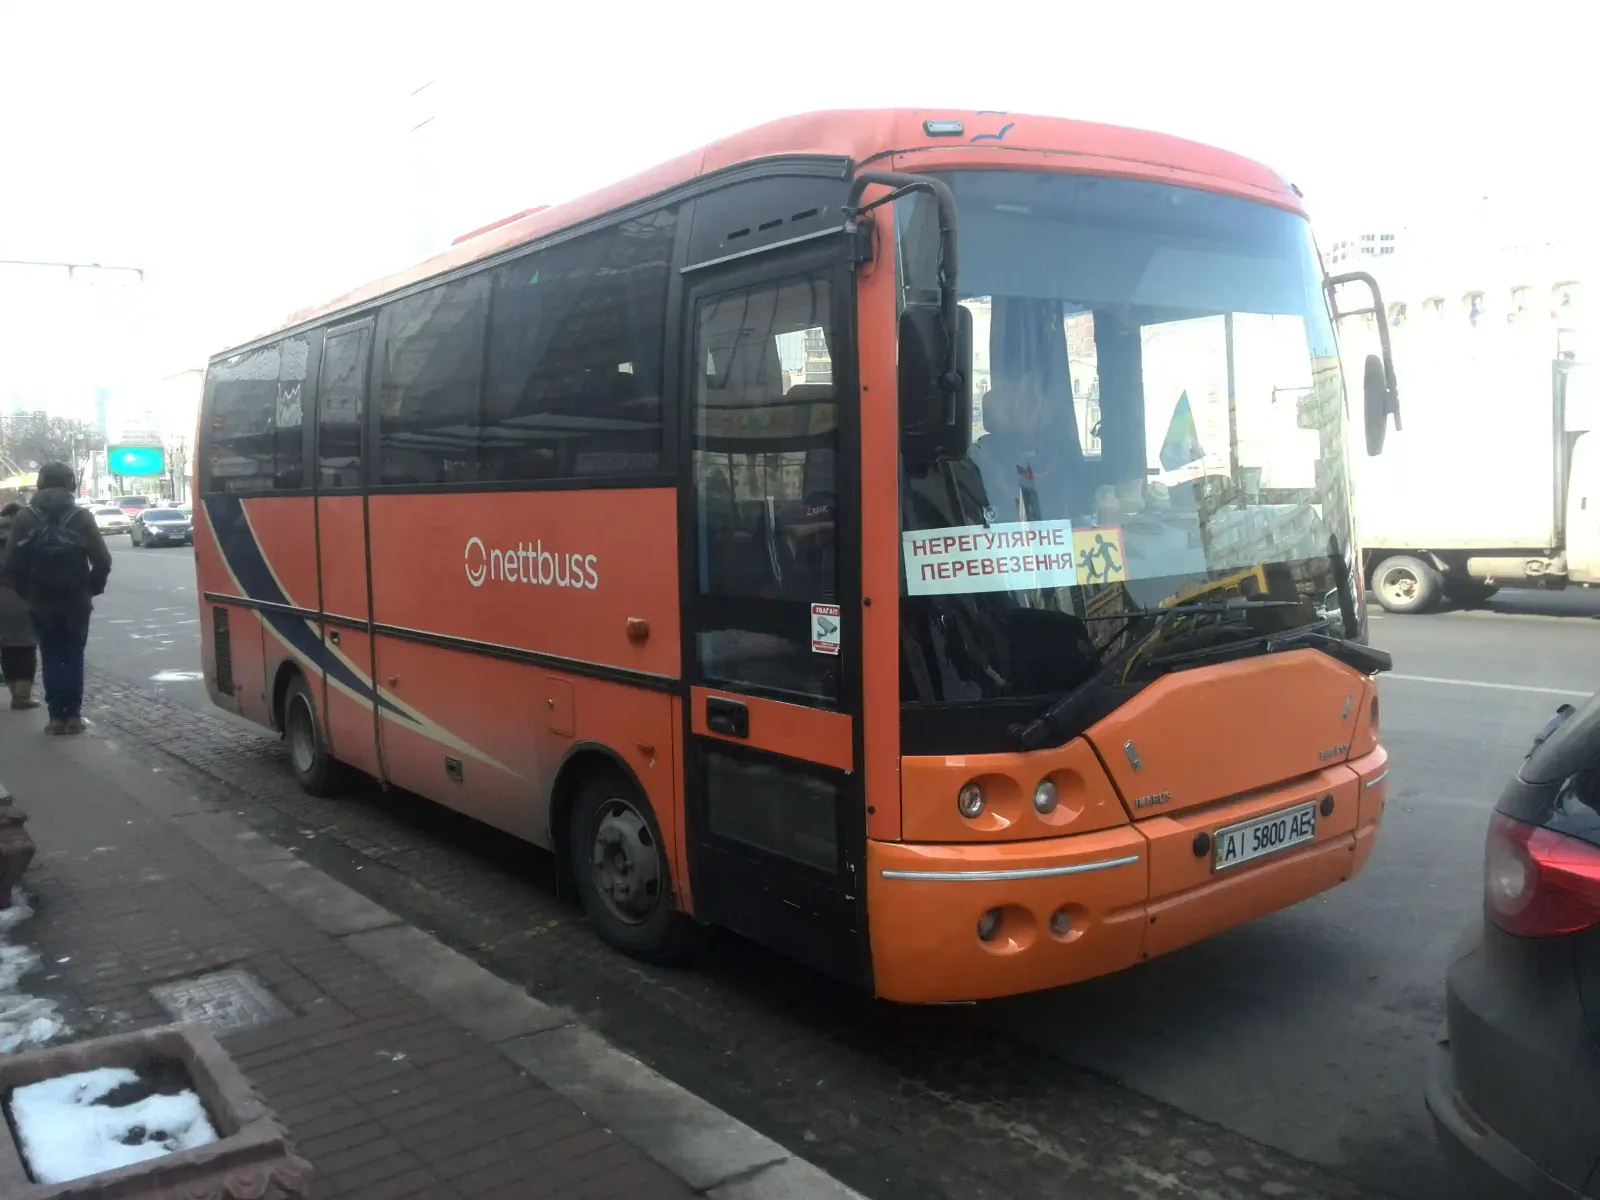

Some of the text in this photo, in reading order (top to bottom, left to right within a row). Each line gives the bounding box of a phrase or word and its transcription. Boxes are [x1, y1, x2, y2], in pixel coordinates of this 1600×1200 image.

[912, 528, 1065, 556] НЕРЕГУЛЯРНЕ
[491, 539, 598, 590] nettbuss
[921, 552, 1073, 580] ПЕРЕВЕЗЕННЯ
[1225, 832, 1245, 861] AI
[1252, 819, 1286, 851] 5800
